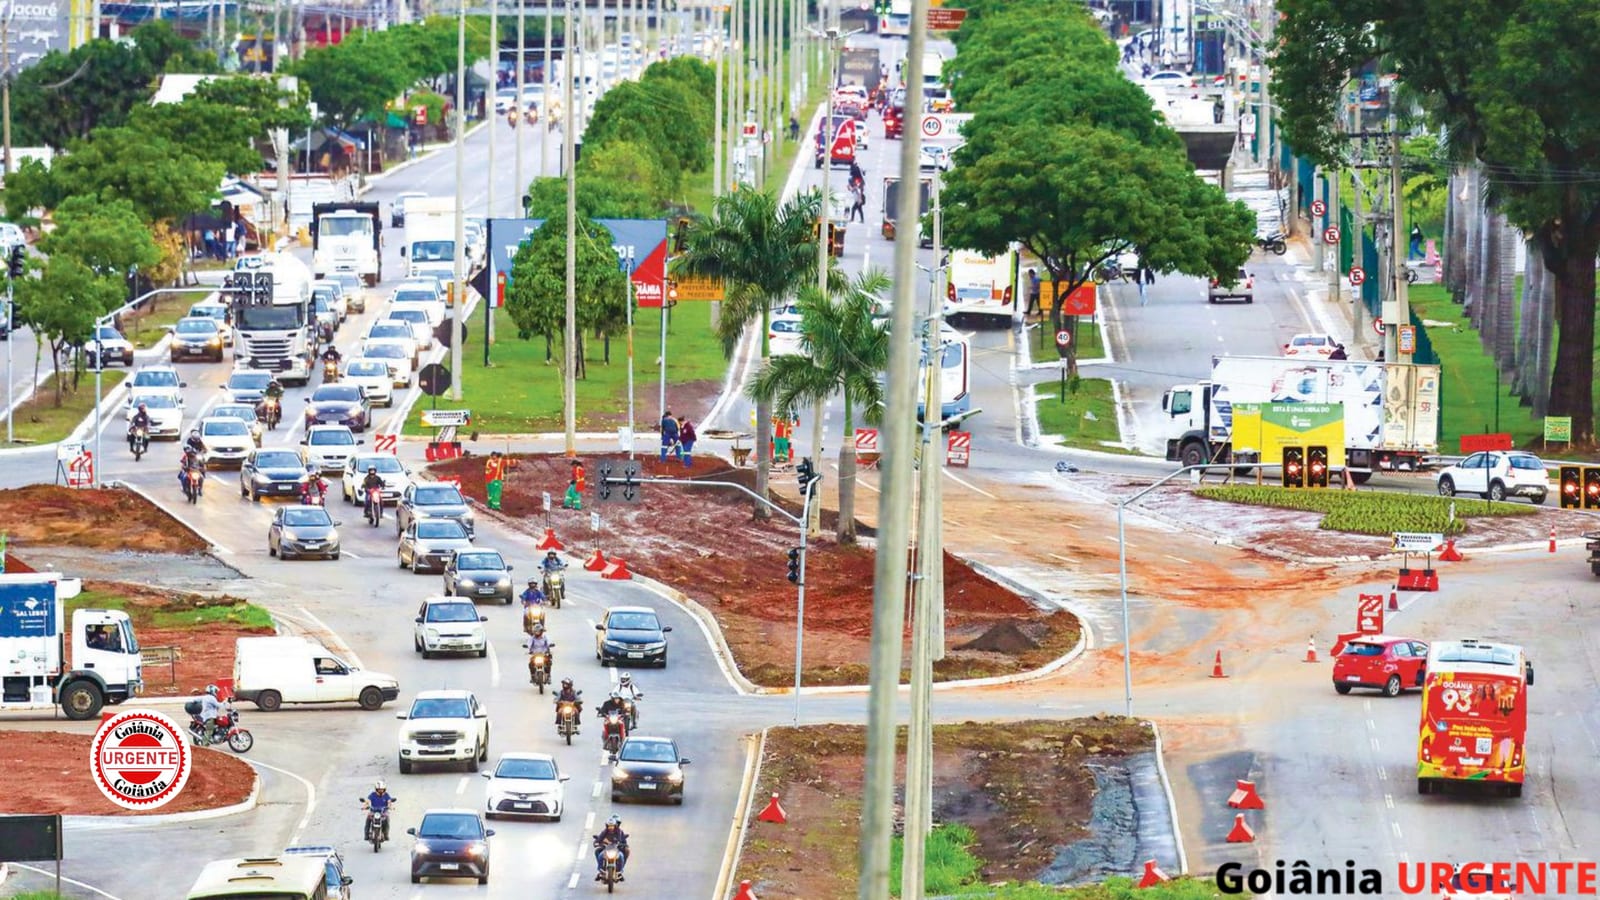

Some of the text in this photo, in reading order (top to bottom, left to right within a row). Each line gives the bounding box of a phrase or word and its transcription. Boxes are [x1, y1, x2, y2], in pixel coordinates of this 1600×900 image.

[925, 121, 939, 130] 40
[1442, 681, 1473, 689] GOIÂNIA
[1442, 689, 1472, 712] 93
